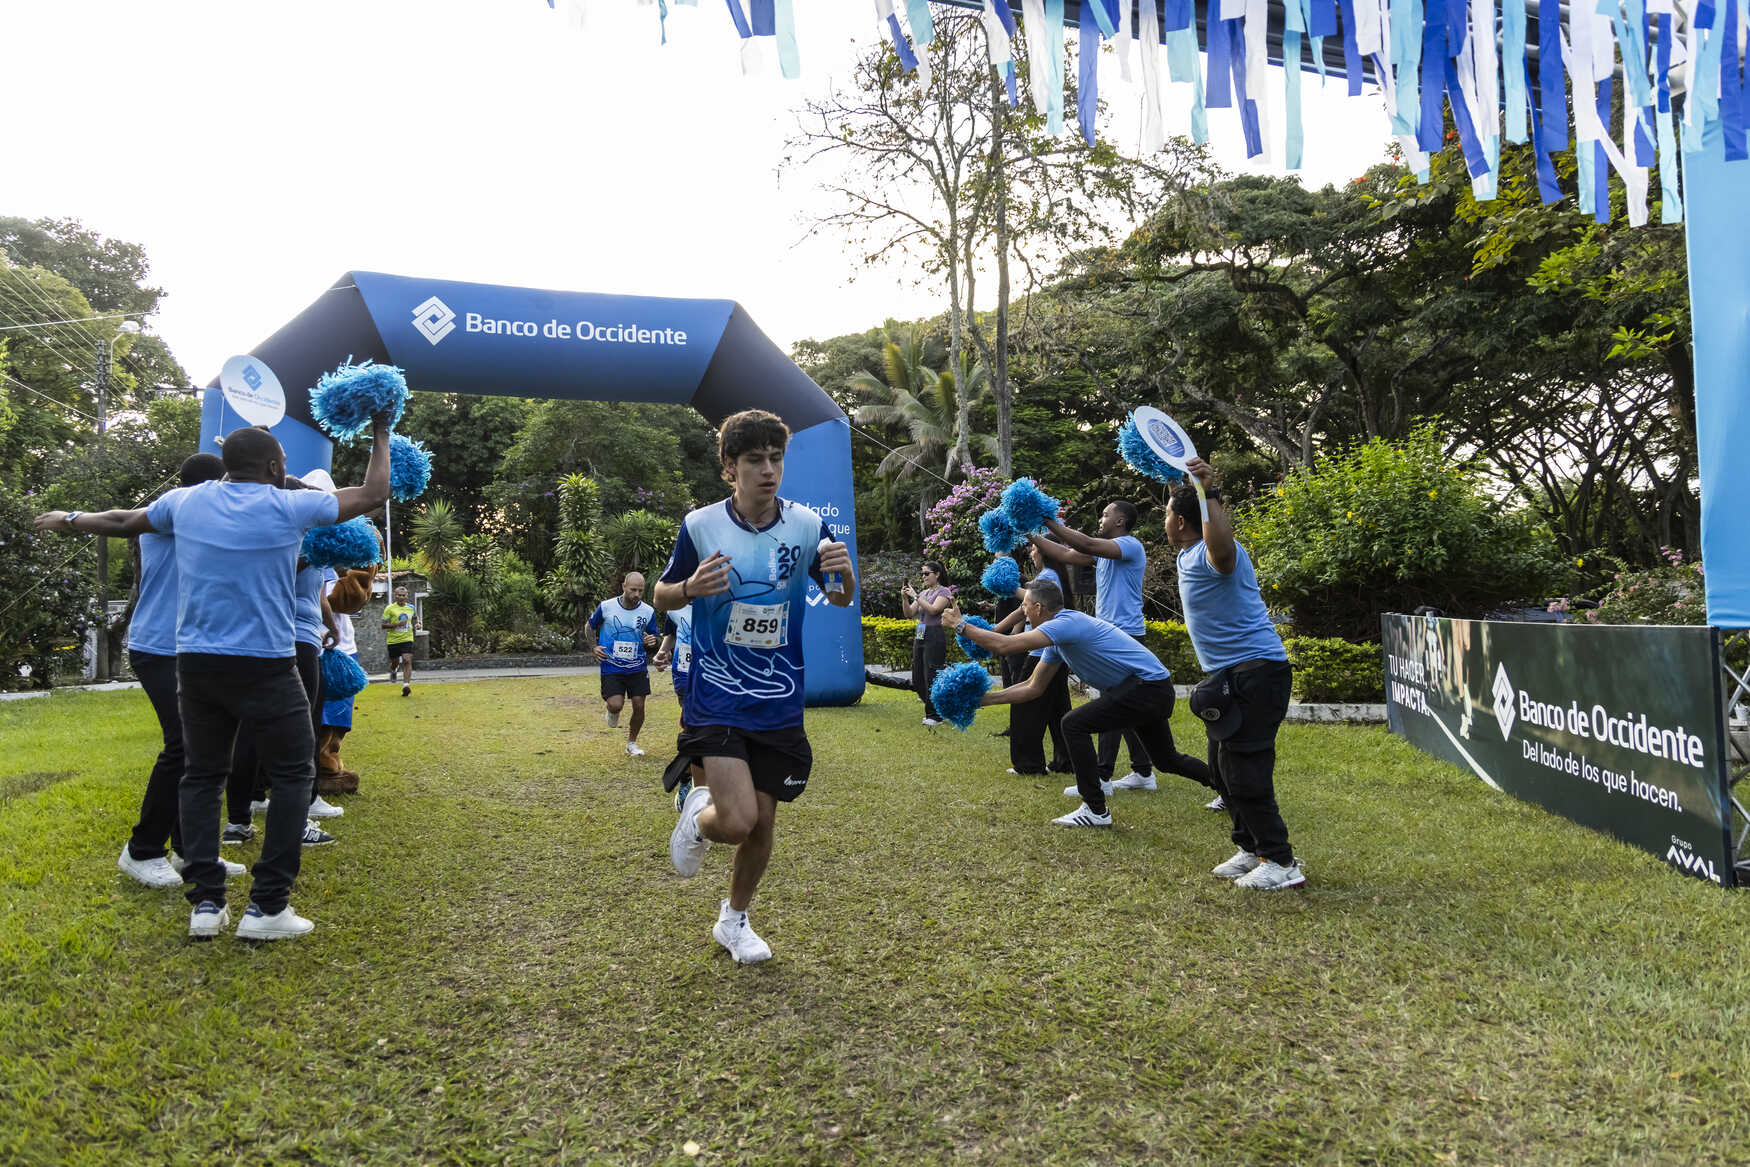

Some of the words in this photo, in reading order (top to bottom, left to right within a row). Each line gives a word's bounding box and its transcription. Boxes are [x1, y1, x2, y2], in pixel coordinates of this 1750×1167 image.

[465, 312, 538, 337] Banco
[543, 319, 572, 339] de
[576, 320, 688, 345] Occidente
[828, 523, 850, 536] que
[777, 545, 801, 563] 20
[743, 618, 778, 633] 859
[1388, 654, 1399, 676] TU
[1399, 657, 1428, 690] HACER,
[1391, 680, 1430, 716] IMPACTA.
[1519, 690, 1564, 732] Banco
[1567, 700, 1590, 738] de
[1591, 704, 1705, 769] Occidente
[1522, 739, 1539, 763] Del
[1540, 743, 1563, 772] lado
[1564, 752, 1580, 776] de
[1581, 756, 1600, 784] los
[1602, 768, 1628, 794] que
[1631, 770, 1683, 813] hacen.
[1671, 834, 1693, 850] Grupo
[1666, 845, 1721, 883] AVAL
